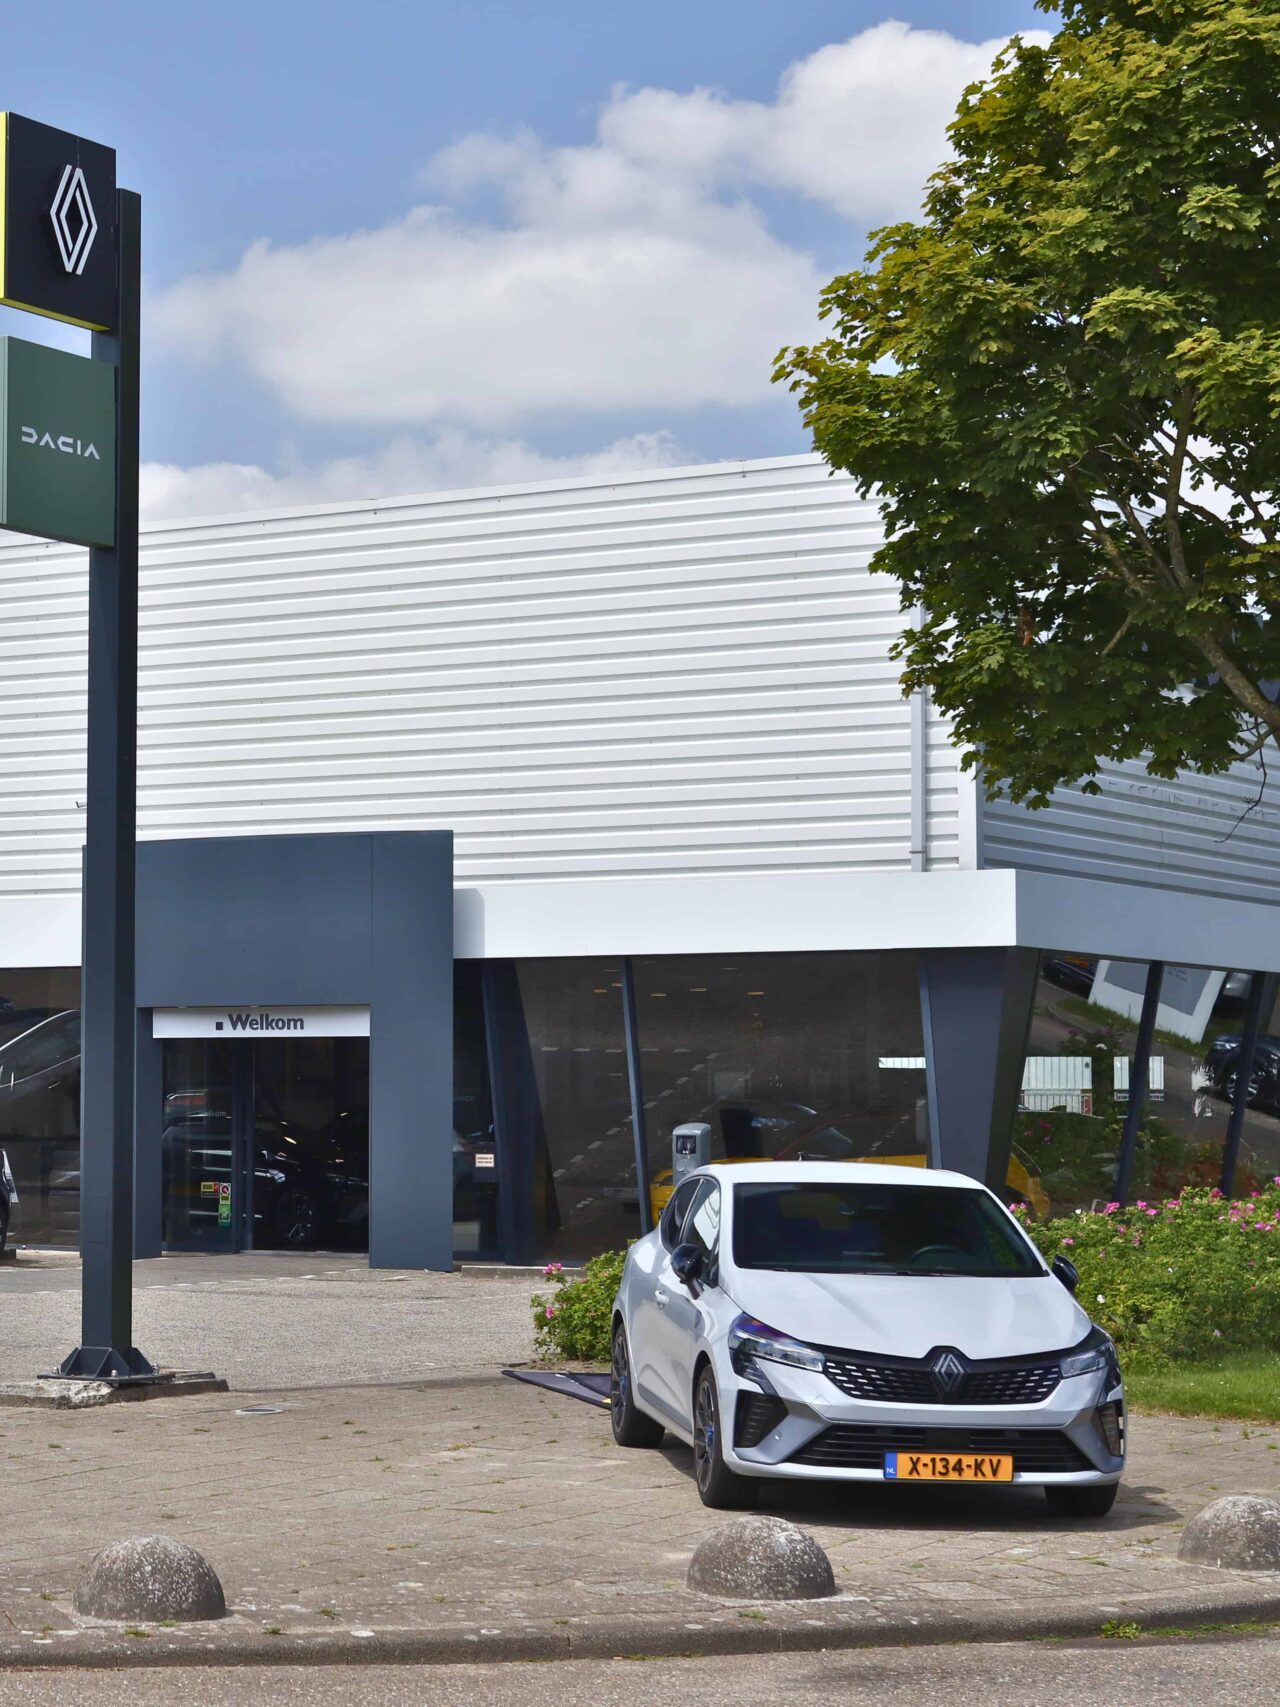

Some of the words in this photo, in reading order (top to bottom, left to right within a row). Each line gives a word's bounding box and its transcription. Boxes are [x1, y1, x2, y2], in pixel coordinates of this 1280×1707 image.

[21, 425, 101, 460] DACIA
[228, 1013, 304, 1031] Welkom
[908, 1456, 1002, 1478] X-134-KV
